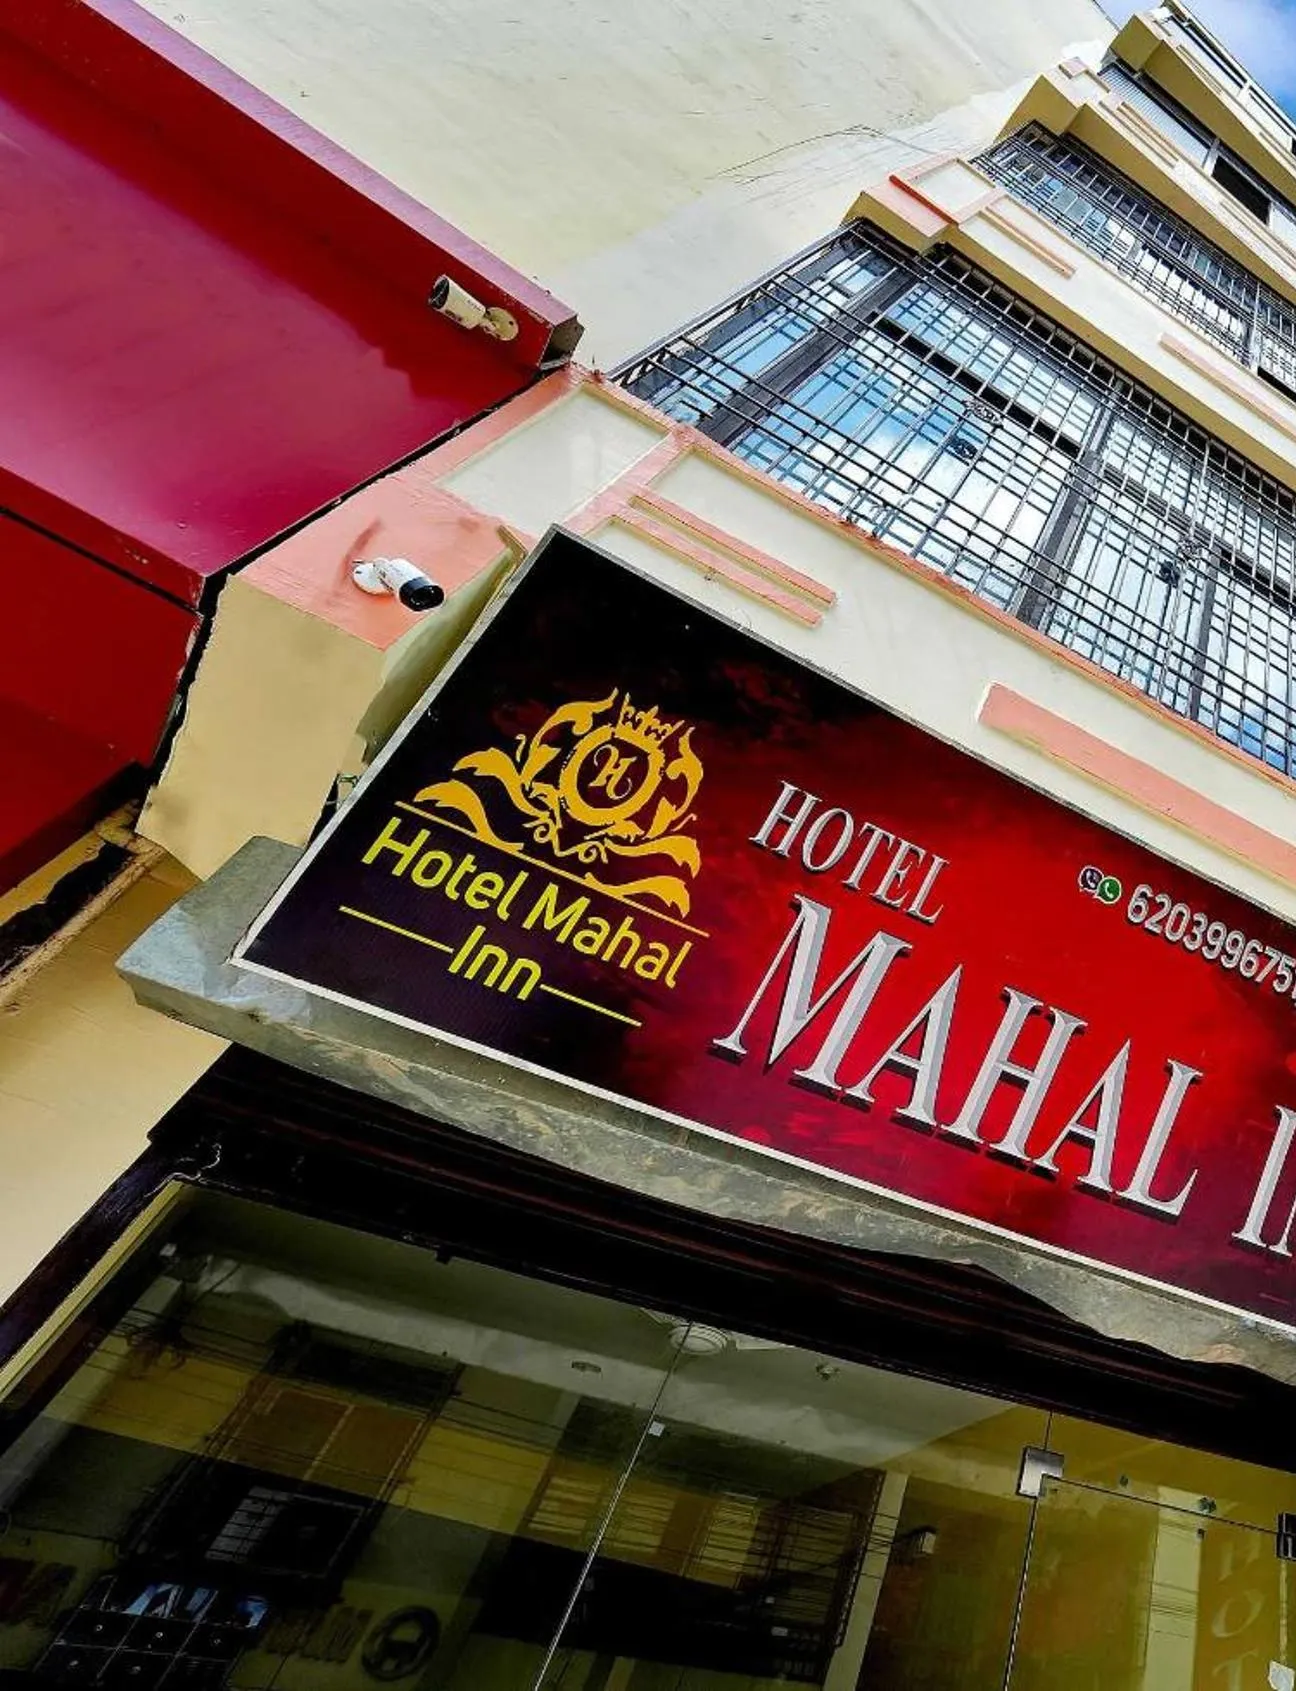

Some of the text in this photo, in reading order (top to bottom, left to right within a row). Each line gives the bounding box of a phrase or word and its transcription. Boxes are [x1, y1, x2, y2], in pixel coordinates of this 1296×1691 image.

[361, 816, 693, 989] Hotel Mahal
[748, 780, 950, 924] HOTEL
[447, 925, 542, 1000] Inn
[711, 893, 1202, 1216] MAHAL
